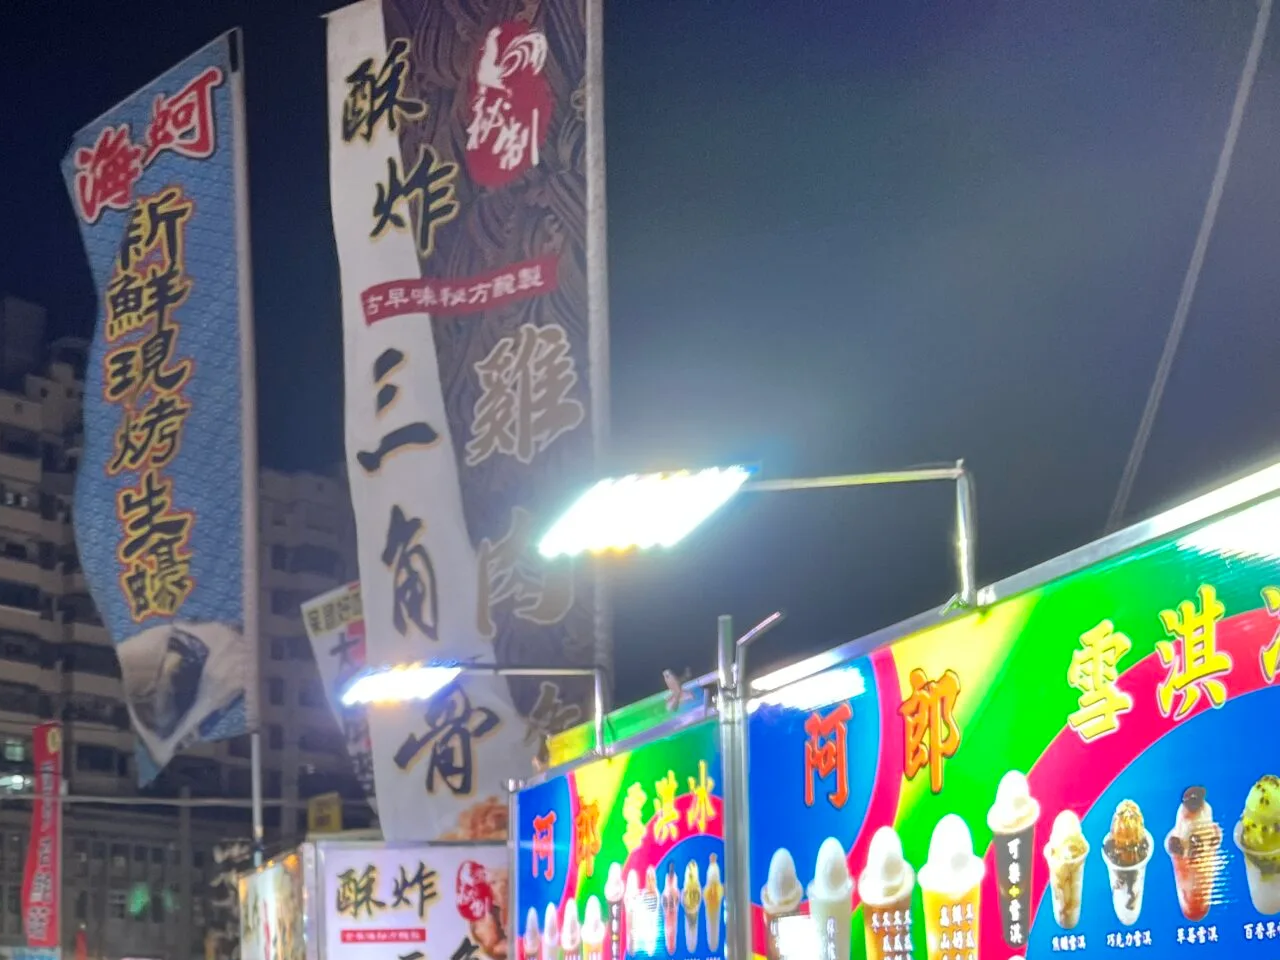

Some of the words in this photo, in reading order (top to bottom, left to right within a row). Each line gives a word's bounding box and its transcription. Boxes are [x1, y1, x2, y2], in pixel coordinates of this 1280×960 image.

[803, 667, 962, 809] 阿郎
[531, 796, 601, 882] 阿郎
[336, 860, 438, 920] 酥炸
[1106, 930, 1152, 948] 巧克力雪淇
[1176, 925, 1218, 945] 草莓雪淇
[1243, 921, 1280, 940] 百香果
